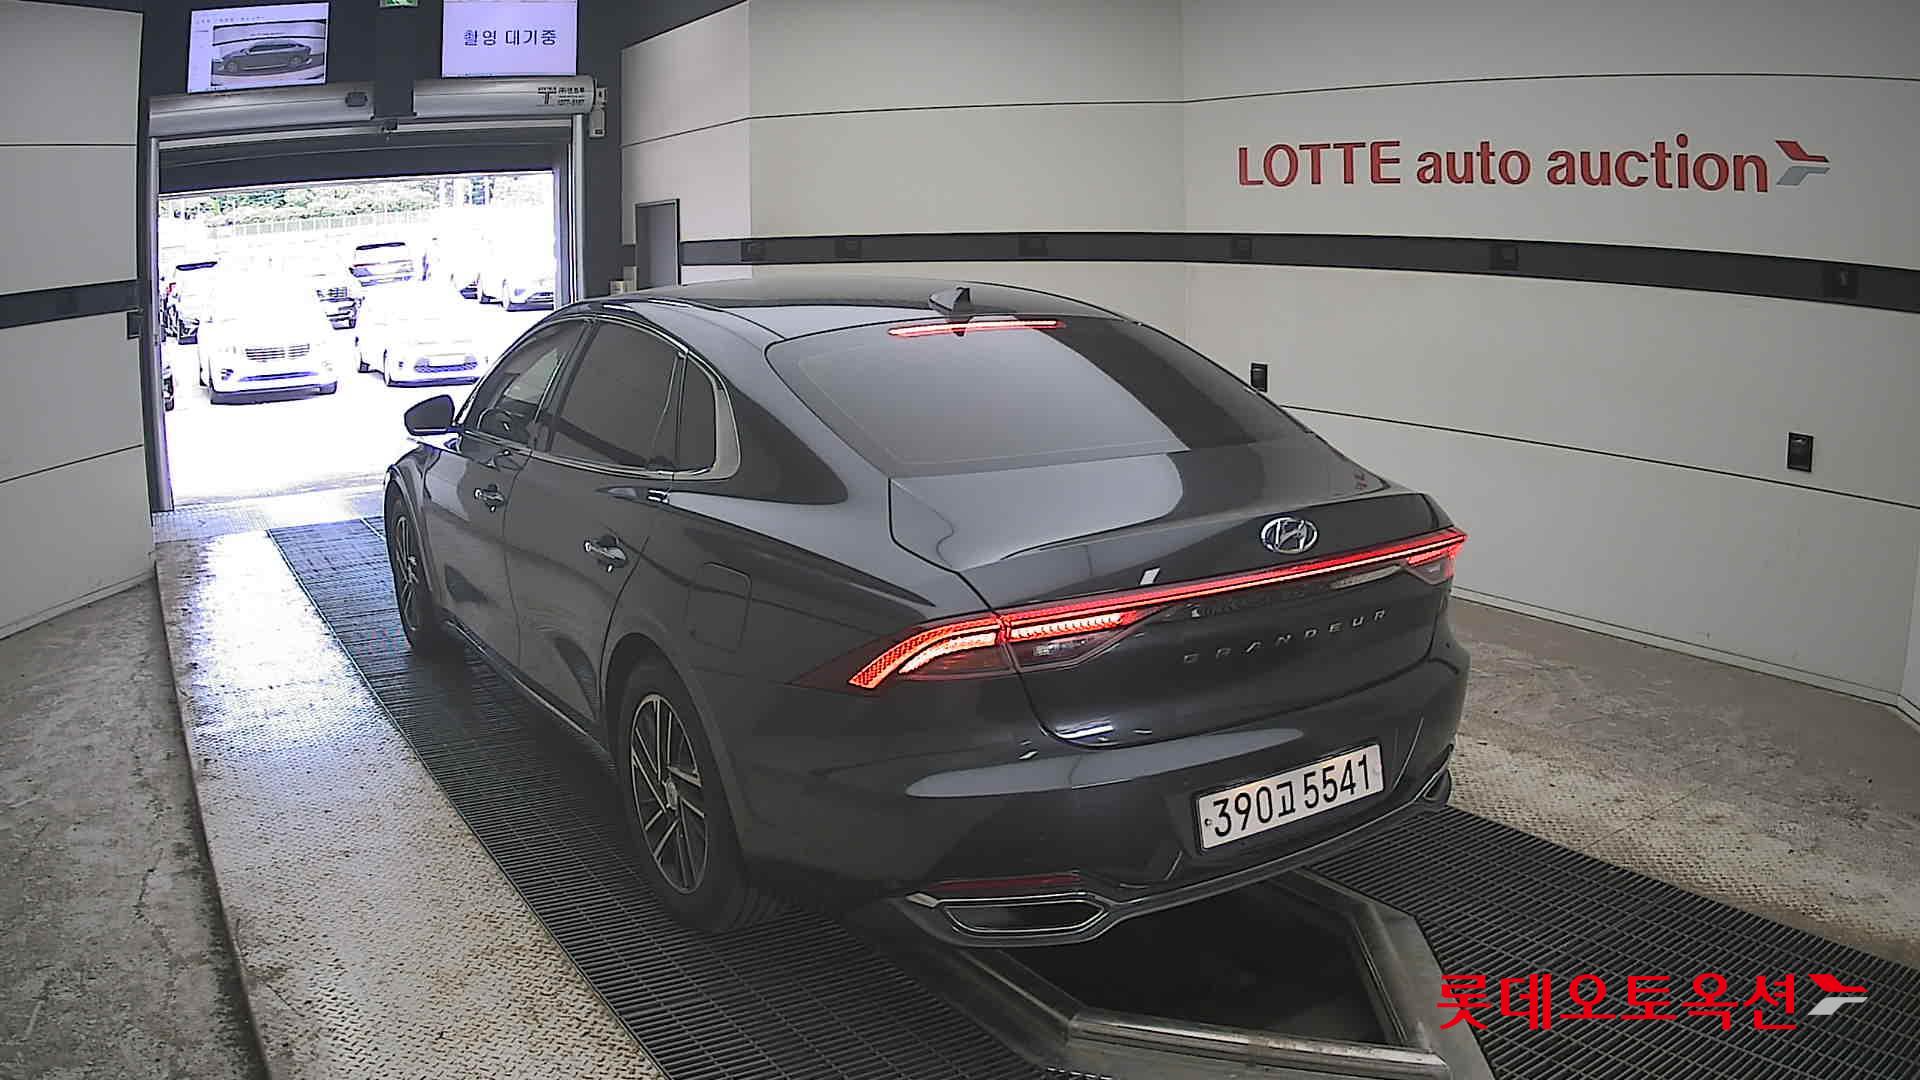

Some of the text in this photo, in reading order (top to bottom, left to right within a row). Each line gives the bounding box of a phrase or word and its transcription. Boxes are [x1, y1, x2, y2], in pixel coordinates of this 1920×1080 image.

[505, 29, 557, 46] 대기중
[1238, 134, 1768, 193] LOTTE auto auction
